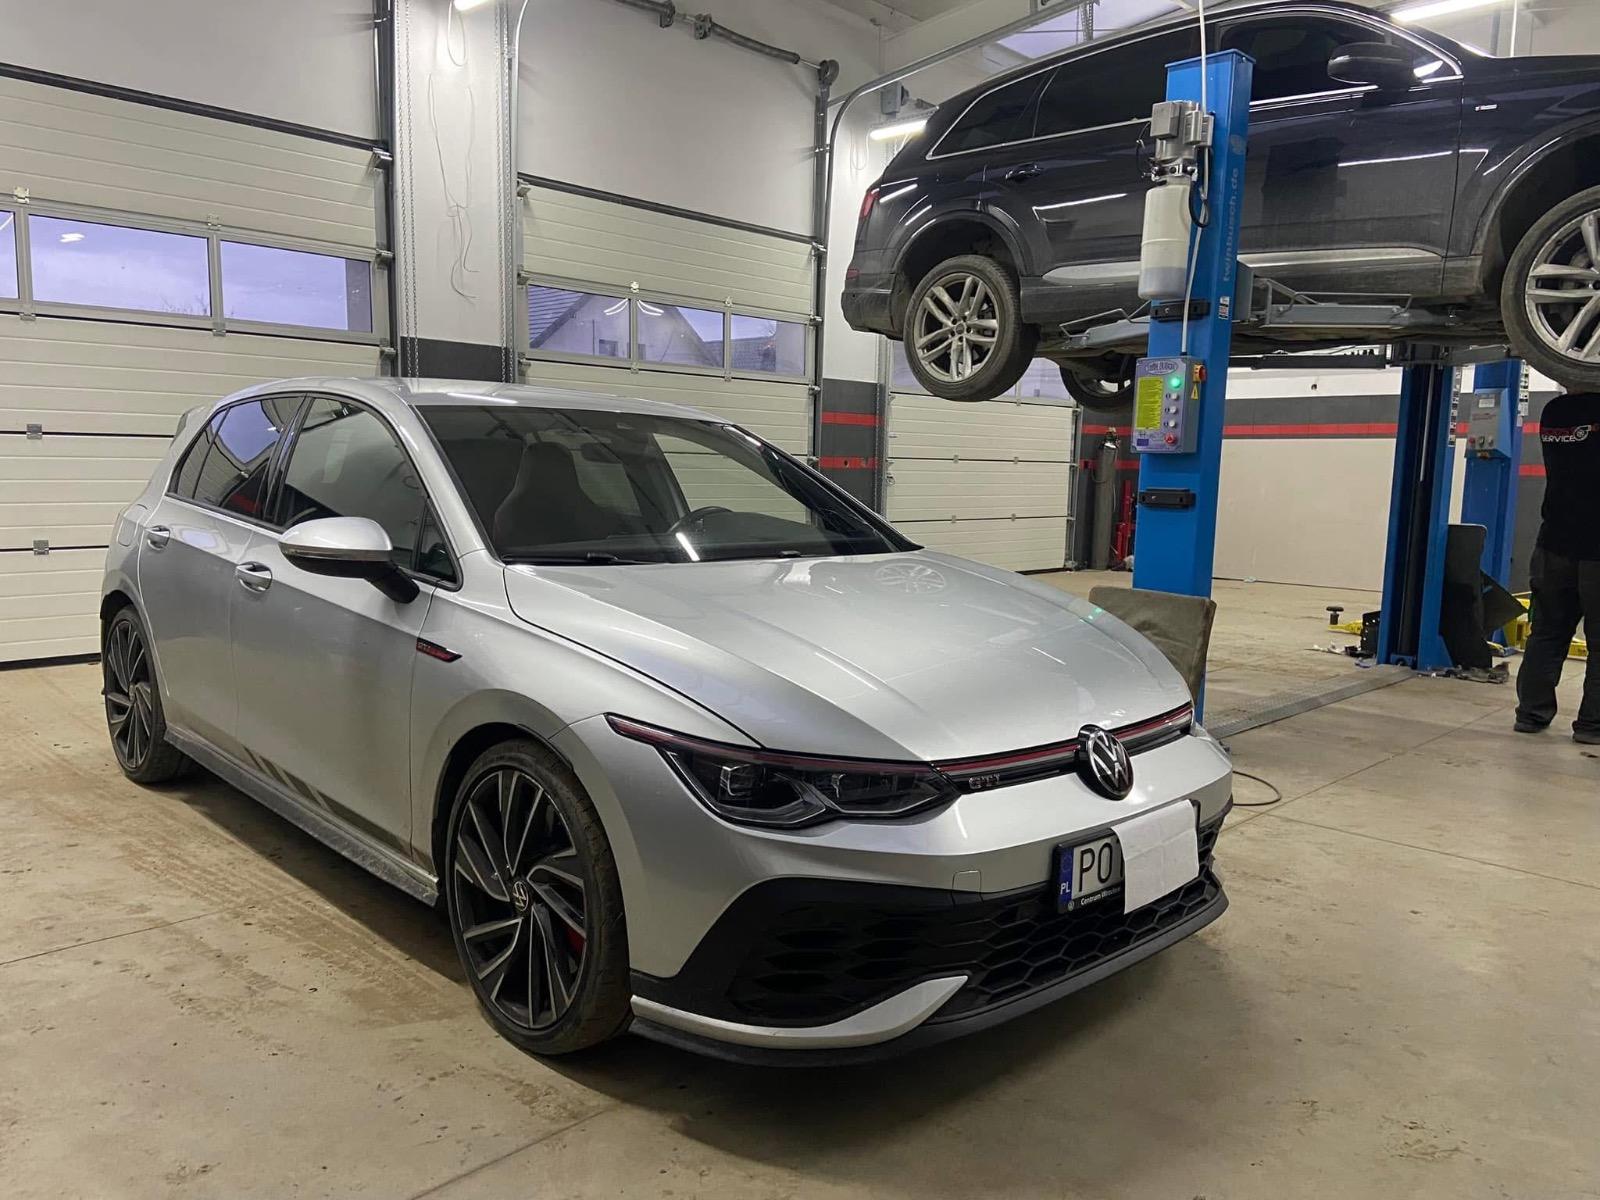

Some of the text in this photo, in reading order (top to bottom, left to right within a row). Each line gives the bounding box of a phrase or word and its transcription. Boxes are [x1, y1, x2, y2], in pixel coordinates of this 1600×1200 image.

[968, 772, 1000, 789] GTI
[1078, 842, 1113, 893] PO
[1060, 881, 1071, 895] PL
